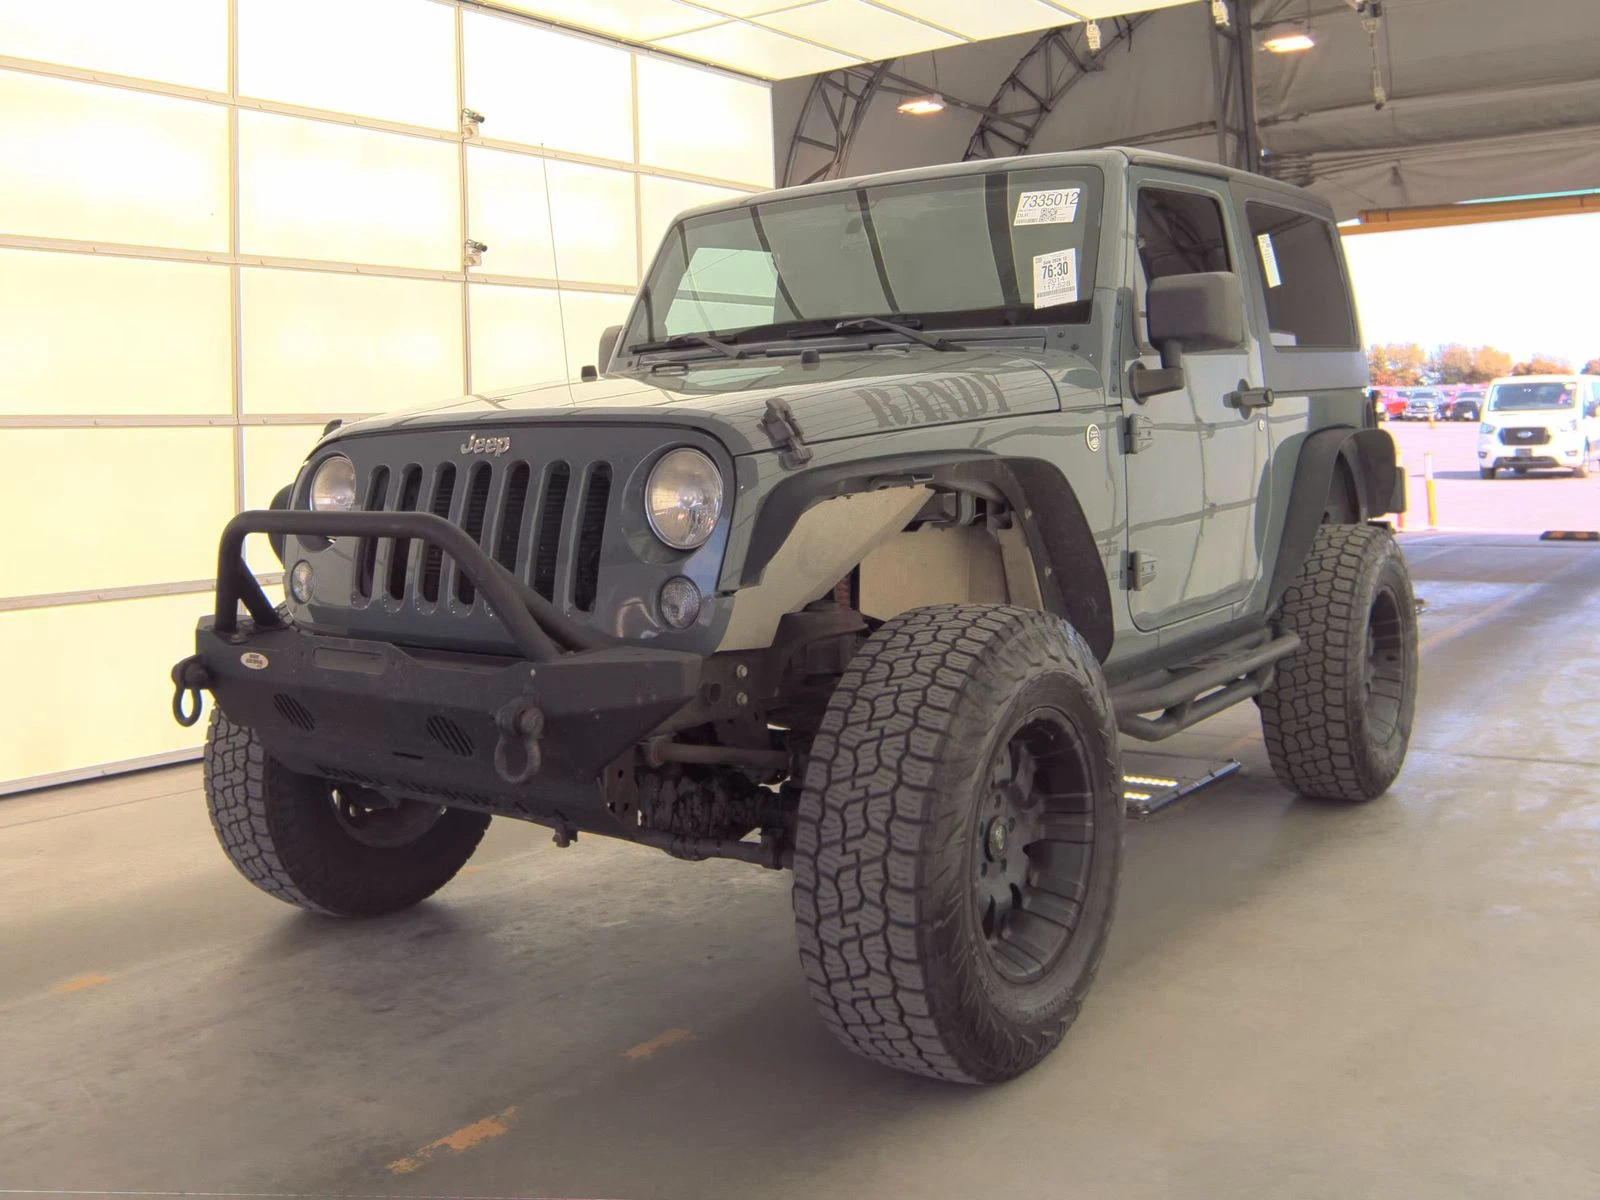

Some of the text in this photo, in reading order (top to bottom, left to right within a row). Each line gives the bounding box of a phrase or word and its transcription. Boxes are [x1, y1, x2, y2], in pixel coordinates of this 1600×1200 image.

[1022, 191, 1079, 209] 7335012
[1041, 261, 1068, 279] 76:30
[1047, 276, 1065, 284] 2014
[460, 433, 511, 457] Jeep
